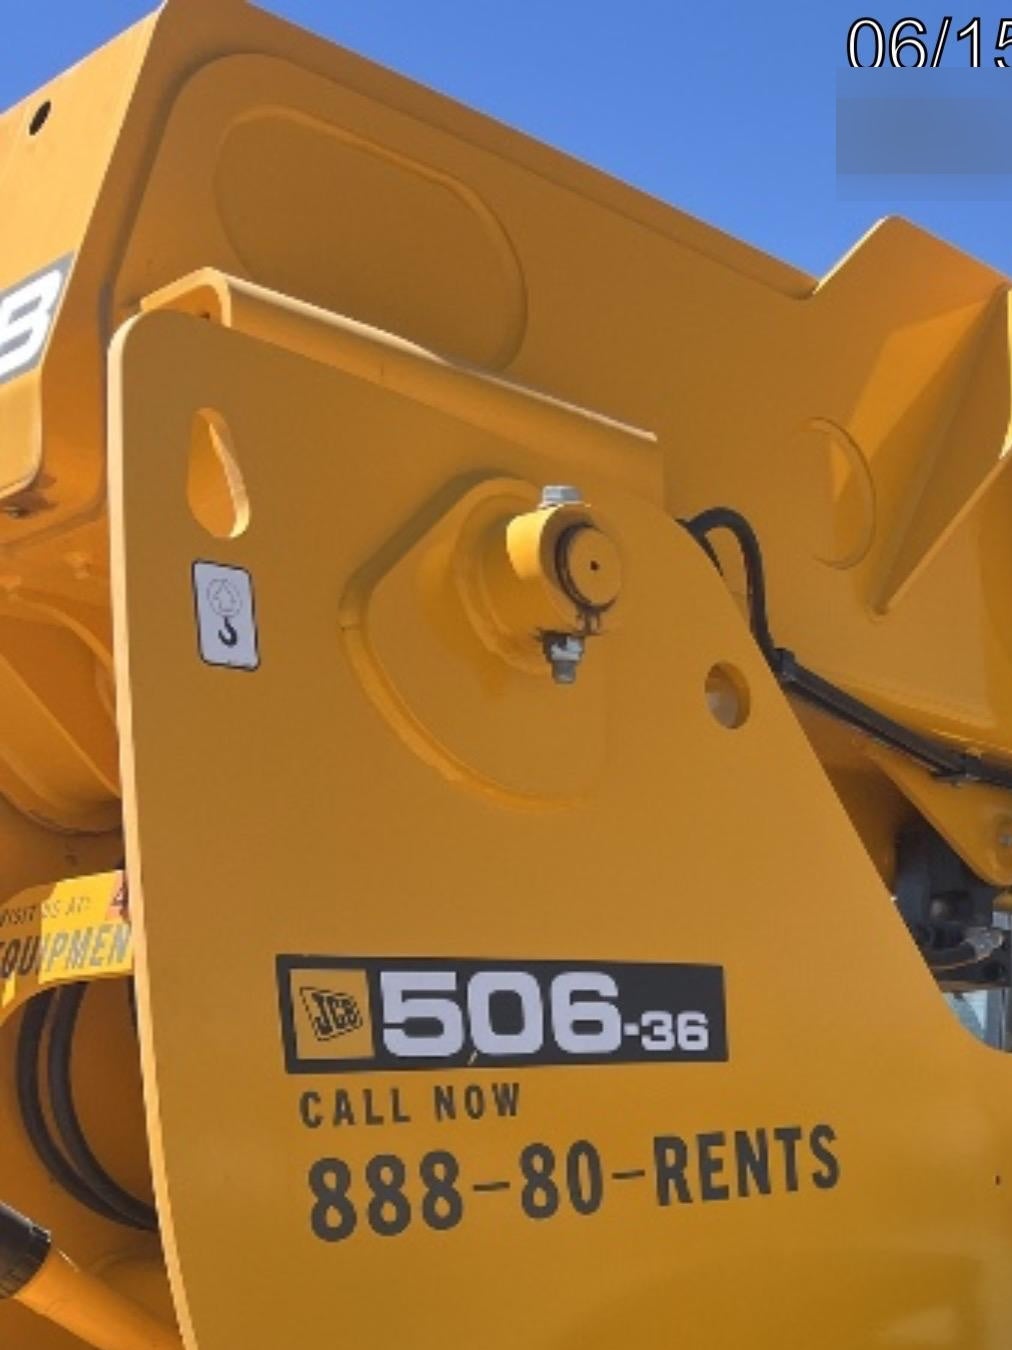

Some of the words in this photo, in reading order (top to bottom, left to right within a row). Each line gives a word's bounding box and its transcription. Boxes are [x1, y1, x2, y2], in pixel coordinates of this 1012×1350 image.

[0, 922, 132, 978] QUIPMEN
[311, 990, 359, 1037] JCB
[380, 970, 711, 1057] 506-36
[299, 1088, 411, 1128] CALL
[433, 1082, 521, 1121] NOW
